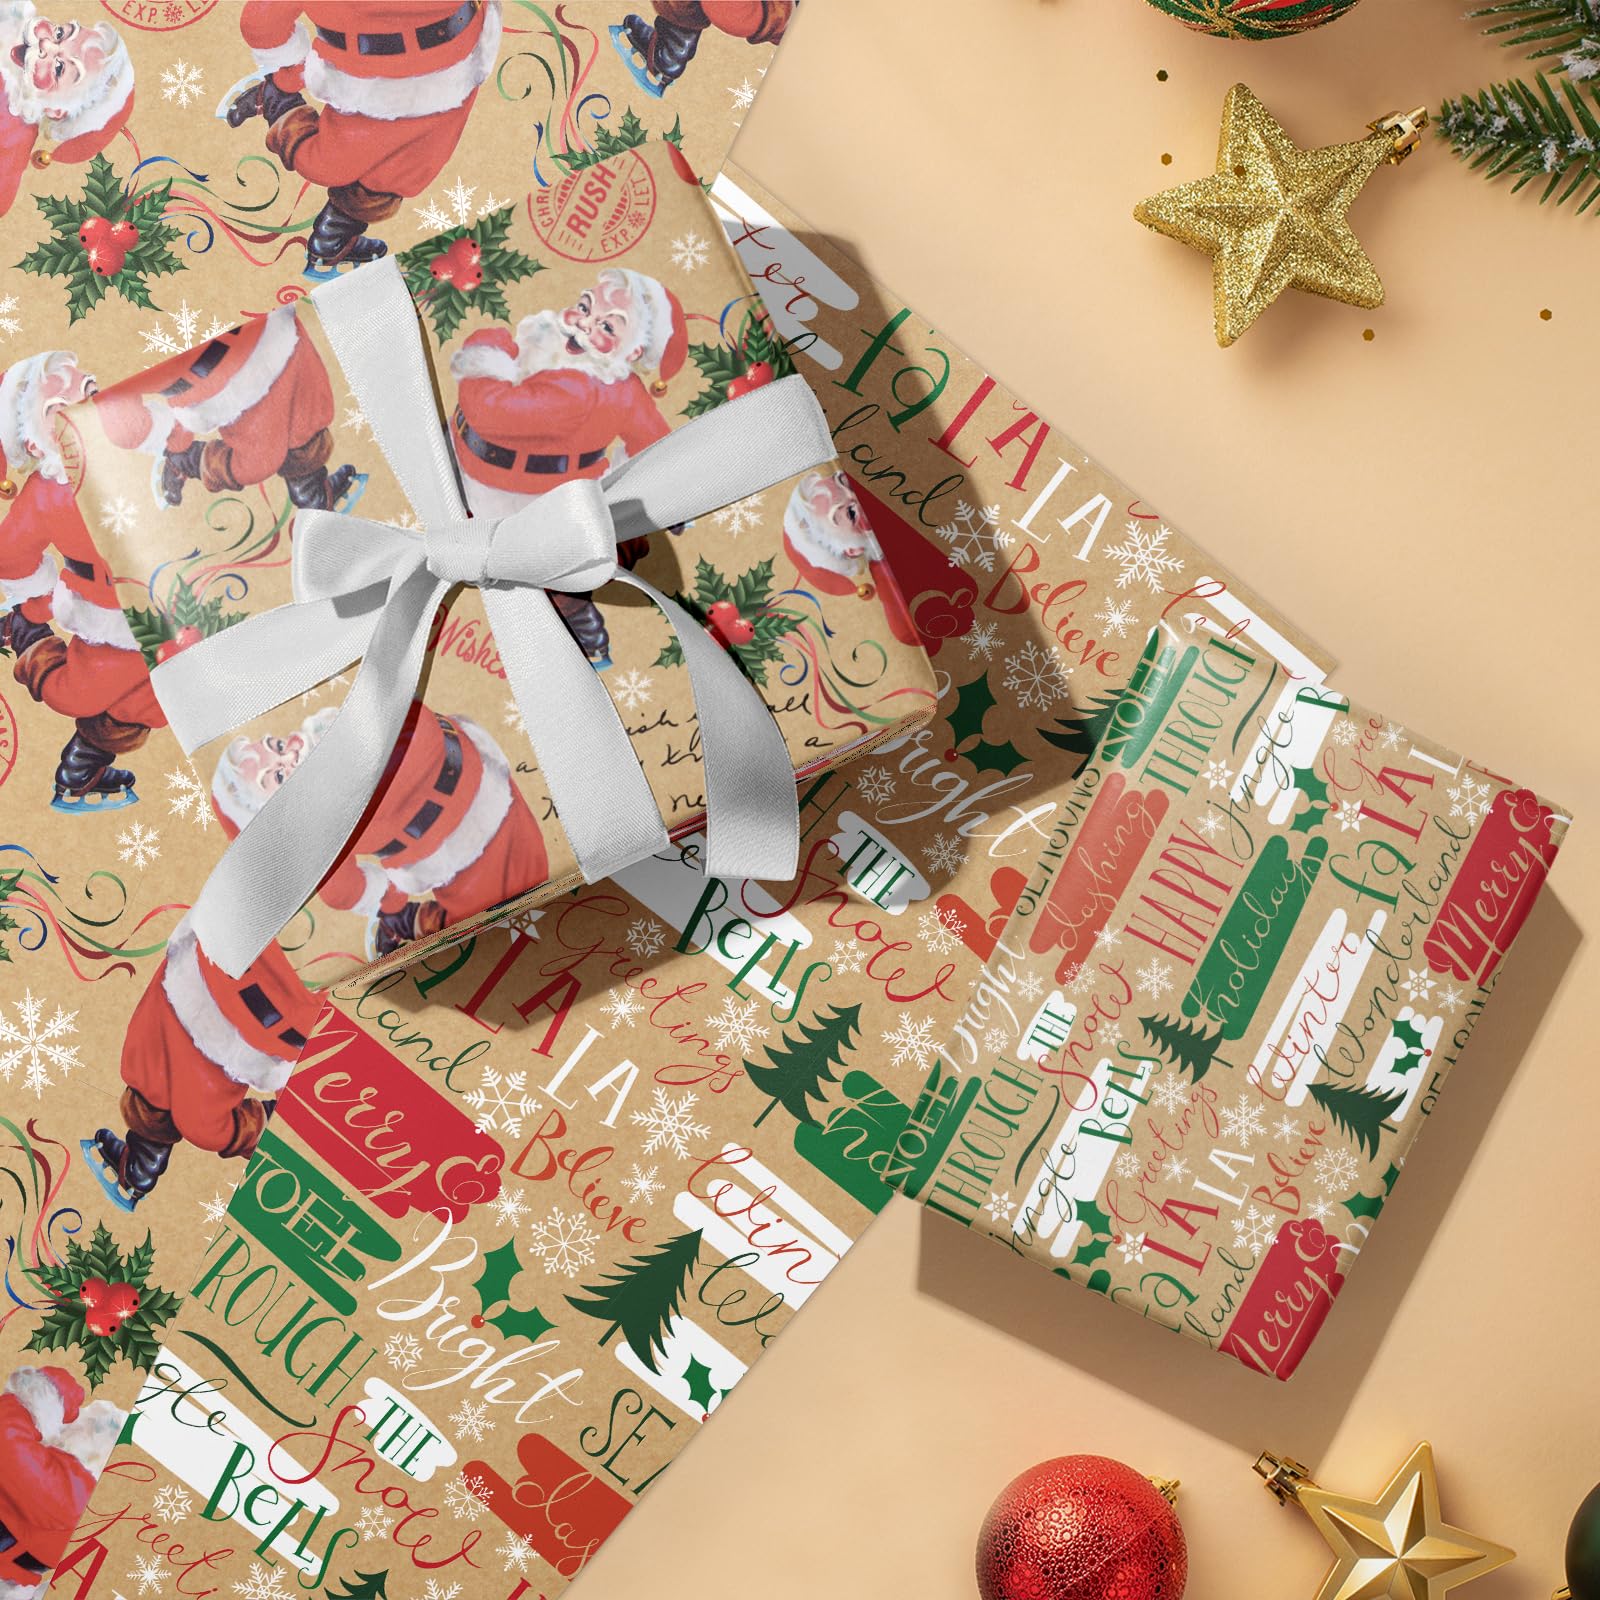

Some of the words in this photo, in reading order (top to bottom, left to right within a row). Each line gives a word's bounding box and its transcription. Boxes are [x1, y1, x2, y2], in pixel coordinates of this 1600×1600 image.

[565, 163, 618, 239] RUSH
[600, 228, 635, 254] EXP.
[1011, 457, 1113, 563] LA
[982, 543, 1121, 677] Believe
[741, 838, 956, 1003] Snow
[837, 828, 916, 911] THE
[1046, 800, 1158, 952] dashing
[1123, 819, 1245, 967] HAPPY
[1423, 836, 1551, 982] Merry
[539, 895, 745, 1094] Greetings
[1313, 815, 1471, 1082] Wonderland
[454, 922, 584, 1059] LA
[538, 1022, 641, 1130] LA
[1028, 1002, 1076, 1053] THE
[1037, 959, 1133, 1112] Snow
[509, 1108, 649, 1244] Believe
[924, 1056, 1044, 1228] THROUGH
[1106, 1081, 1220, 1234] Greetings
[1140, 1199, 1220, 1277] LA
[1192, 1148, 1256, 1211] LA
[1251, 1119, 1327, 1216] Believe
[367, 1206, 584, 1424] Bright
[268, 1404, 482, 1569] Snow
[364, 1395, 443, 1479] THE
